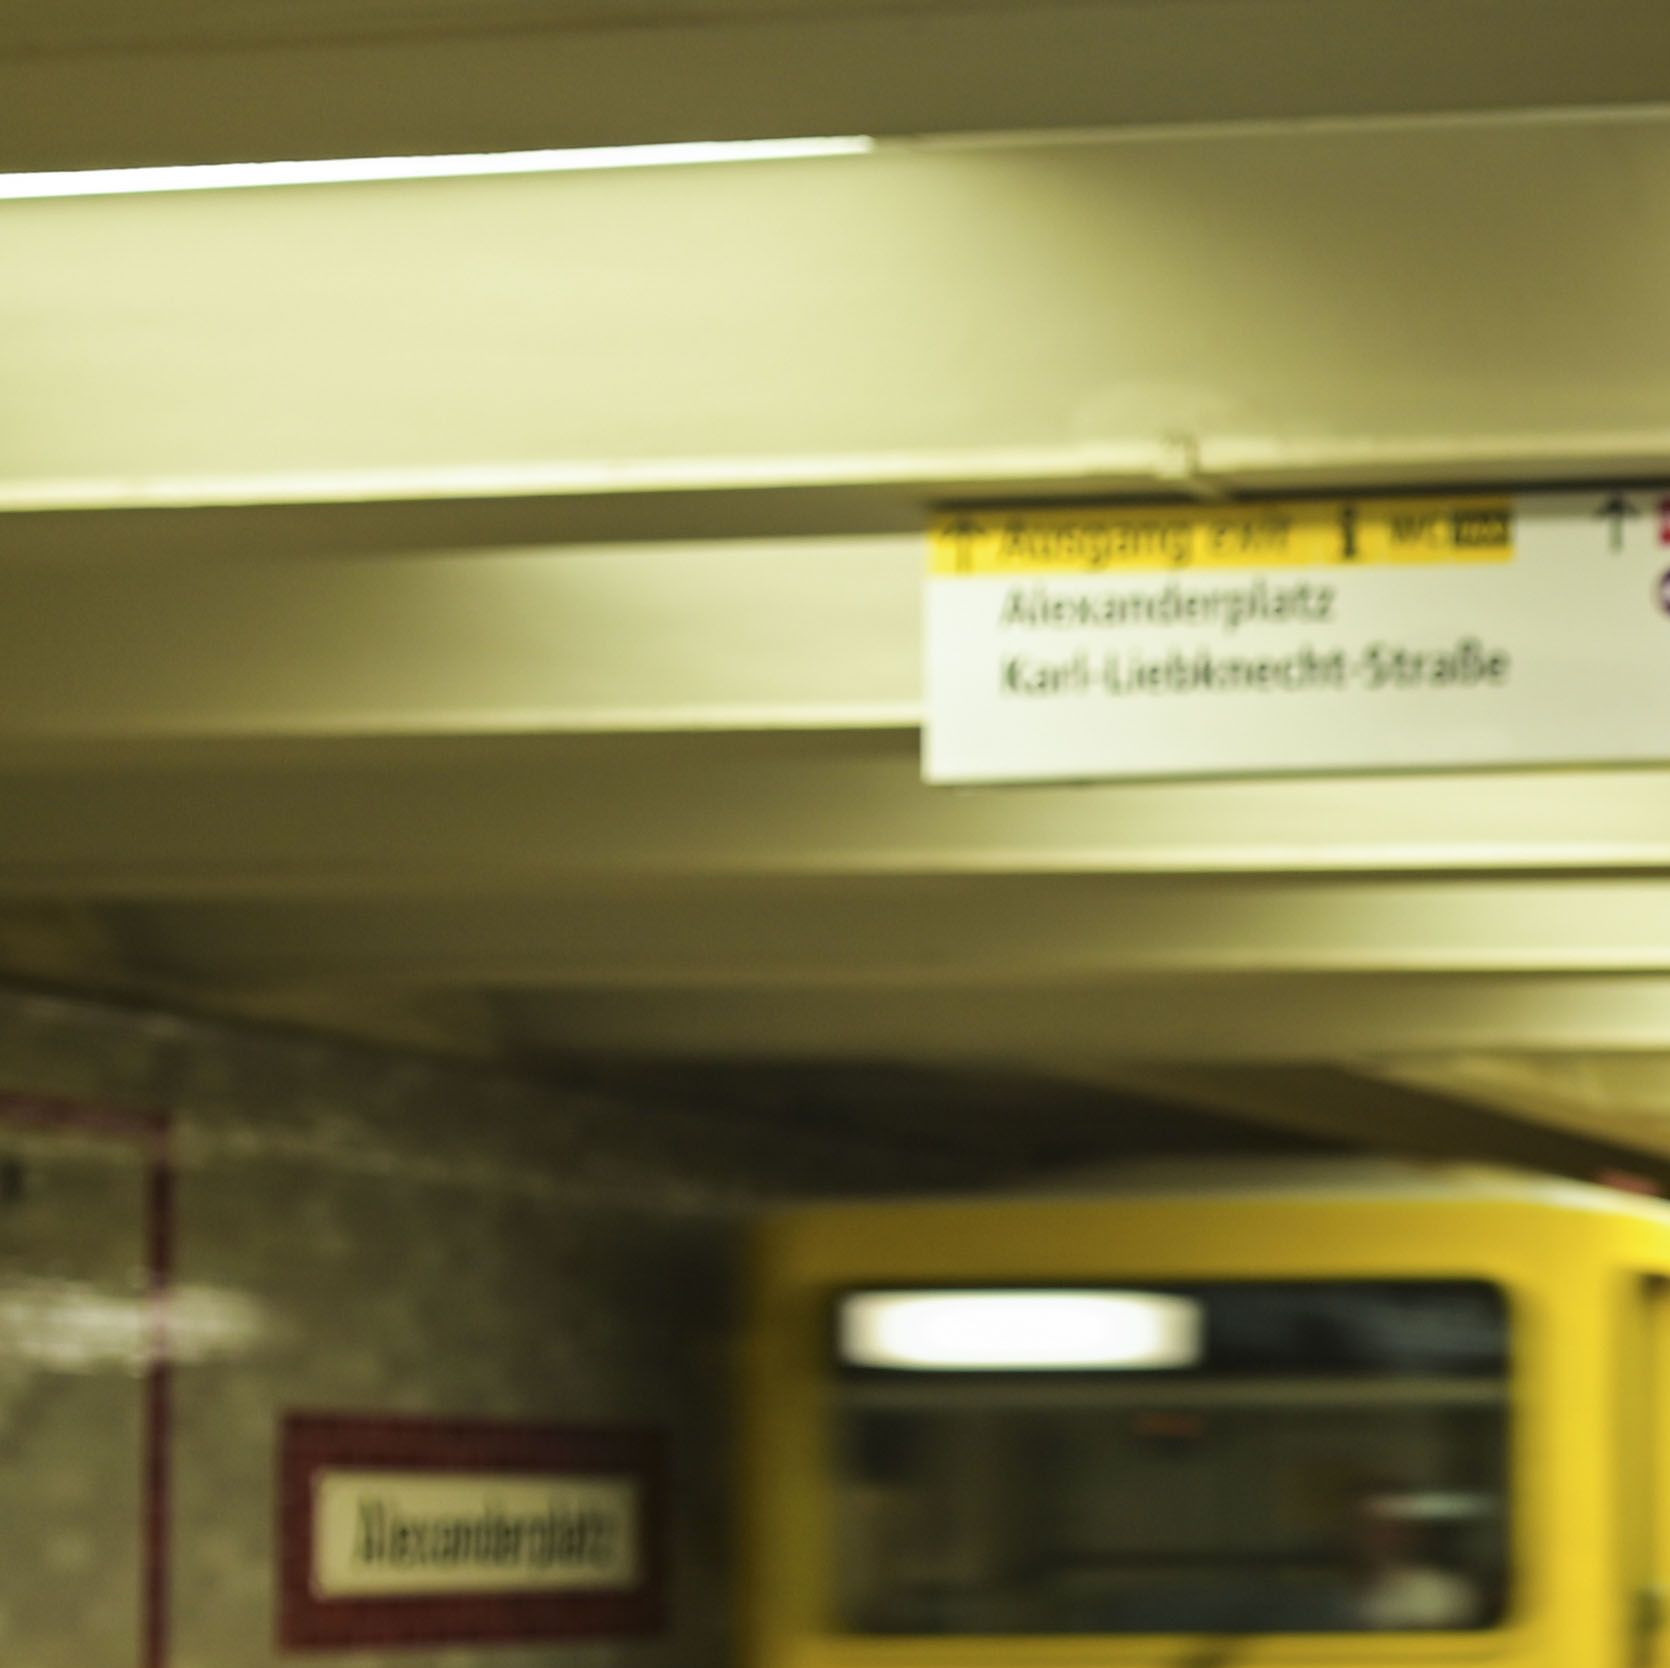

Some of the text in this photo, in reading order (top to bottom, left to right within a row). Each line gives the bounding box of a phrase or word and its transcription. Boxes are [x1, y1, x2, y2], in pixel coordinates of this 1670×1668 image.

[997, 512, 1193, 572] Ausgang
[1001, 580, 1337, 634] Alexanderplatz
[1002, 637, 1510, 697] Karl-Liebknecht-Straße
